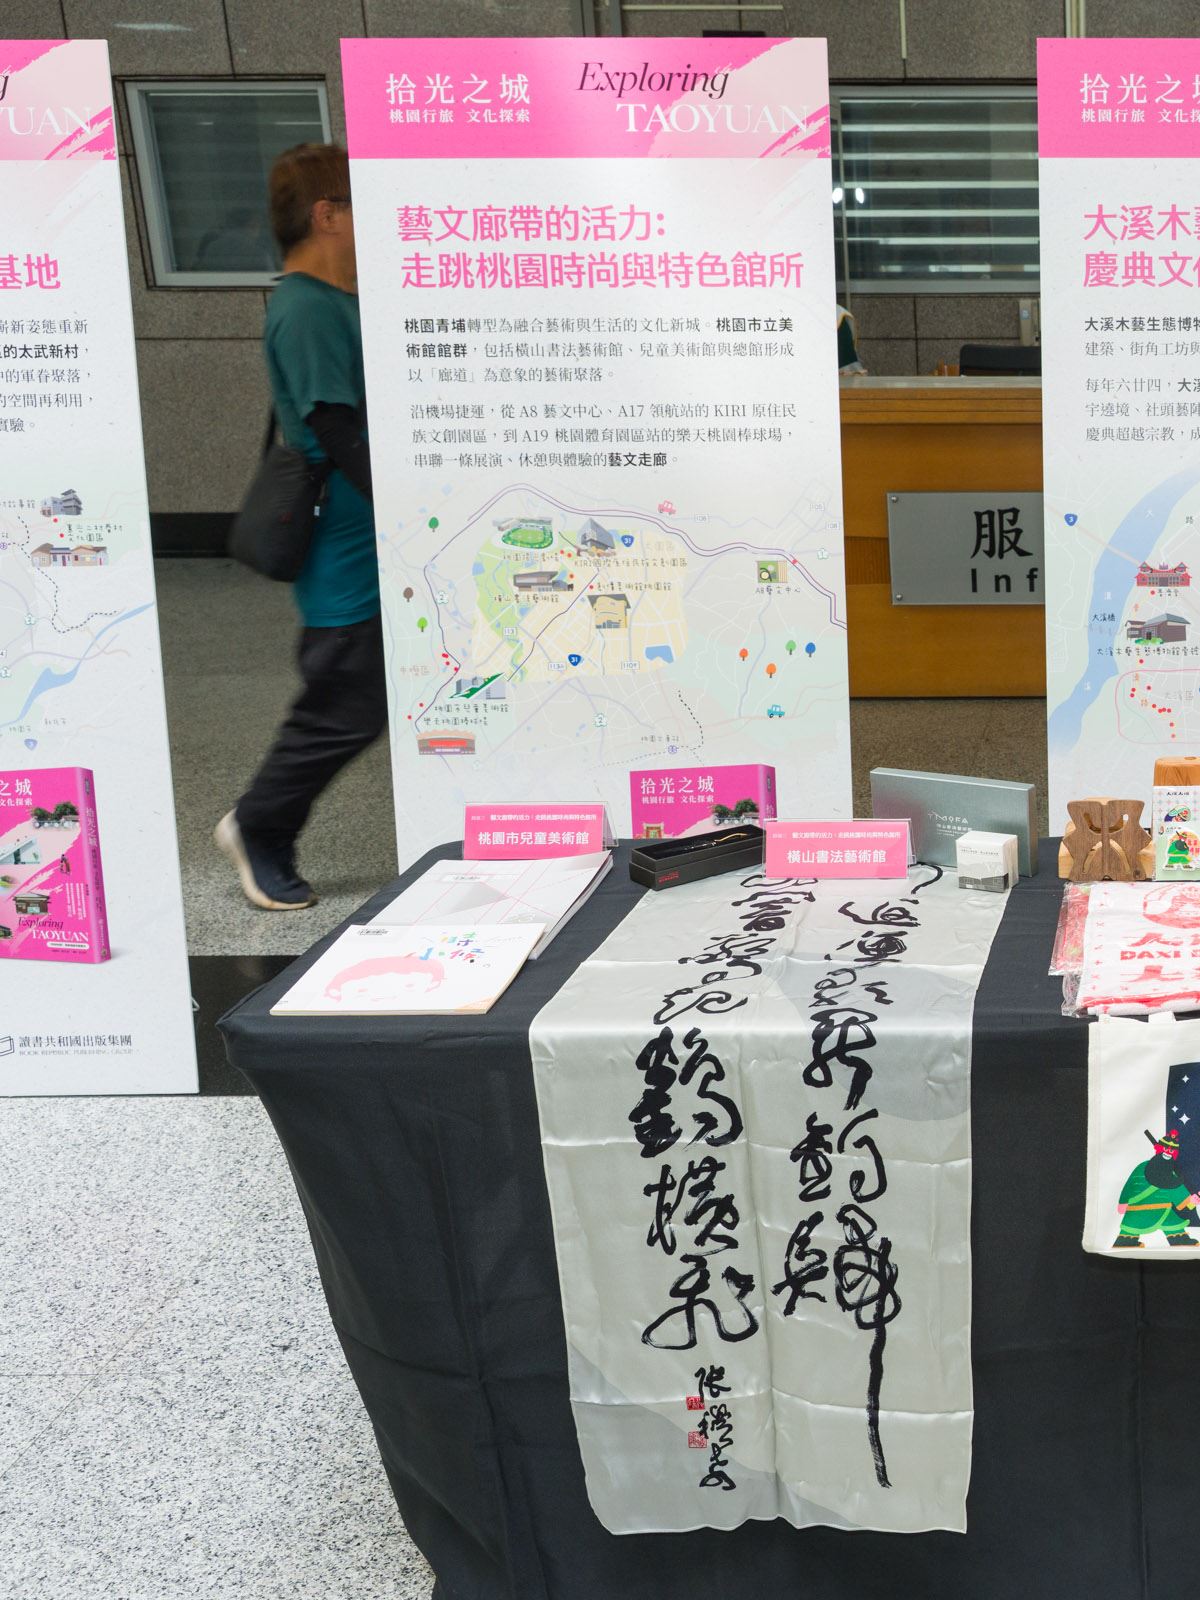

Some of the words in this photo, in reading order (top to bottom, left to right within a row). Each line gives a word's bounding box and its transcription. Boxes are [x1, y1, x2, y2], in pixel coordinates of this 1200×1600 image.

[576, 62, 729, 99] Exploring
[386, 74, 531, 105] 拾光之城
[389, 109, 454, 123] 桃園行旅
[466, 109, 530, 123] 文化探索
[616, 103, 809, 134] TAOYUAN
[1081, 109, 1146, 123] 桃園行旅
[397, 204, 666, 242] 藝文廊帶的活力：
[401, 251, 804, 289] 走跳桃園時尚與特色館所
[0, 344, 89, 359] 的太武新村，
[519, 405, 538, 418] A8
[650, 403, 709, 418] 領航站的
[714, 404, 746, 418] KIRI
[751, 403, 797, 418] 原住民
[522, 430, 549, 443] A19
[970, 507, 1033, 560] 服
[641, 775, 715, 795] 拾光之城
[478, 831, 590, 846] 桃園市兒童美術館
[787, 849, 887, 864] 橫山書法藝術館
[18, 916, 64, 930] Exploring
[32, 930, 89, 942] TAOYUAN
[1120, 949, 1181, 961] DAXI
